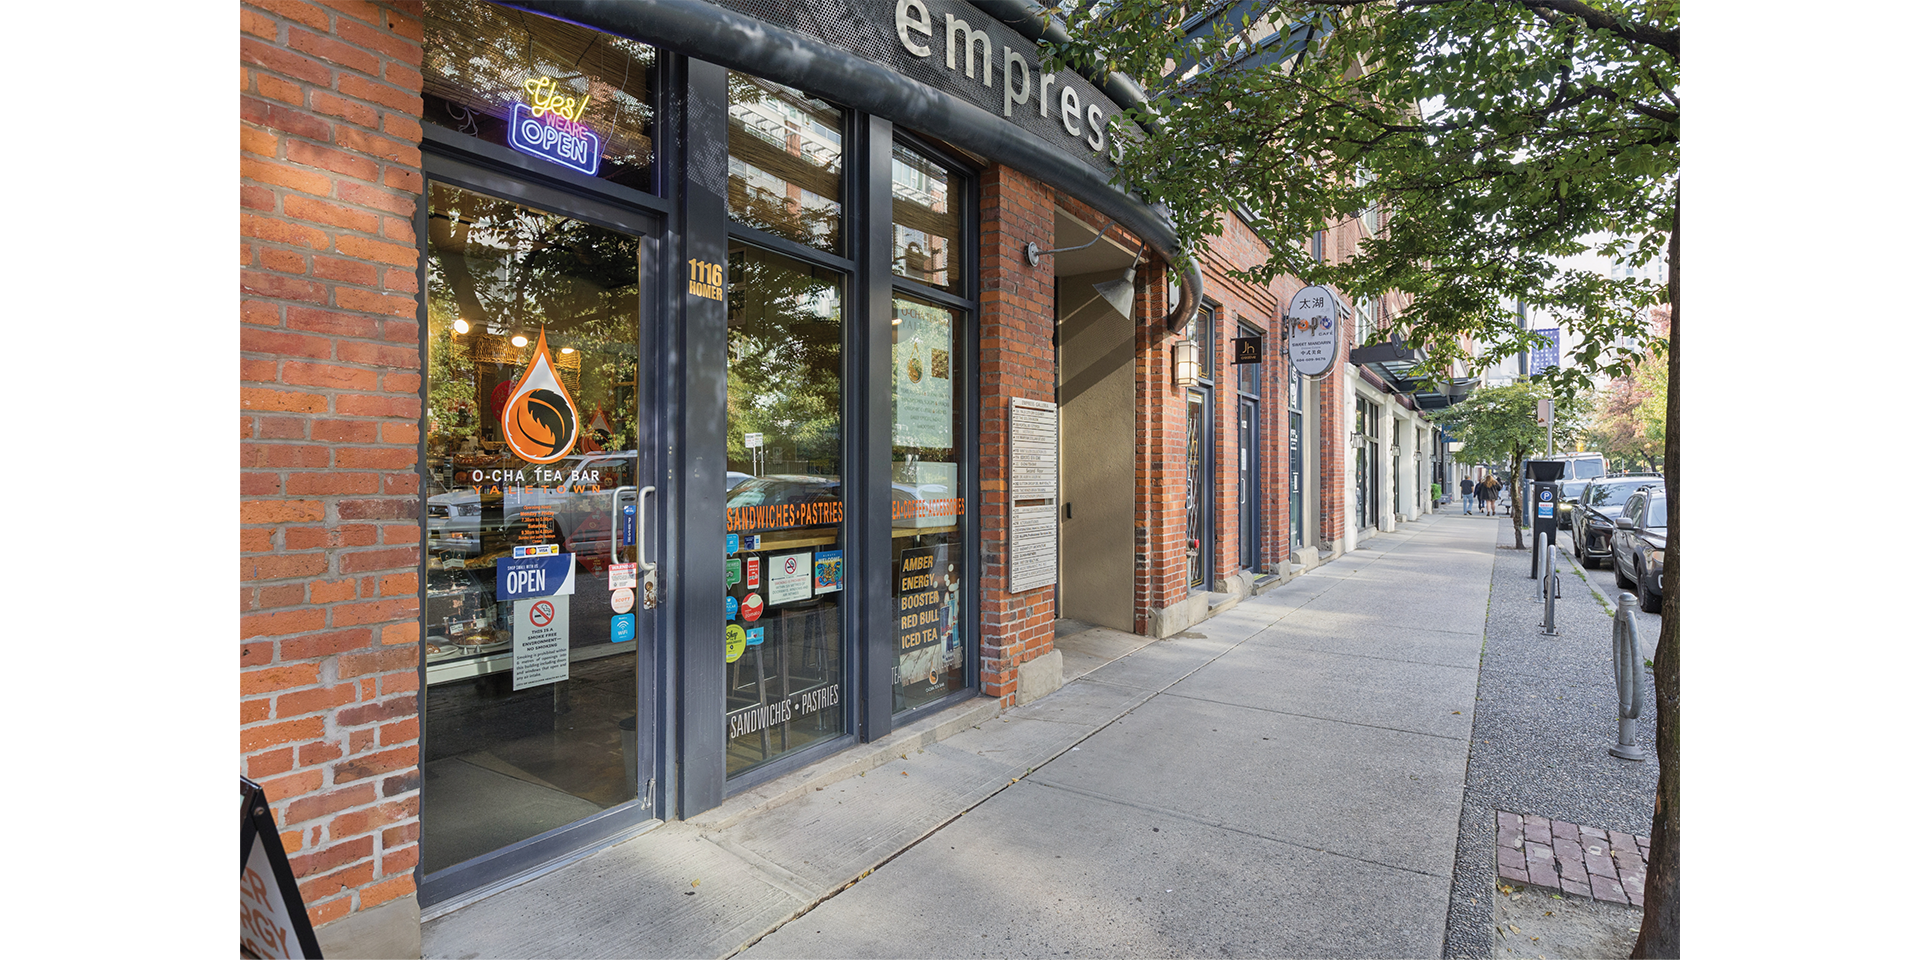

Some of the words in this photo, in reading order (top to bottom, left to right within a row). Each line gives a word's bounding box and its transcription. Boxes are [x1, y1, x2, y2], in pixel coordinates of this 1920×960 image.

[895, 0, 1125, 166] empress
[525, 76, 590, 123] Yes!
[521, 119, 588, 164] OPEN
[688, 258, 723, 287] 1116
[688, 280, 723, 302] HOMER
[1299, 297, 1324, 310] 太湖
[472, 469, 525, 482] O-CHA
[534, 469, 563, 482] TEA
[571, 469, 600, 482] BAR
[472, 484, 601, 495] YALETOWN
[1543, 492, 1550, 500] P
[892, 500, 900, 520] EA
[902, 555, 934, 572] AMBER
[506, 569, 546, 595] OPEN
[902, 573, 935, 591] ENERGY
[901, 590, 940, 611] BOOSTER
[901, 613, 918, 630] RED
[920, 609, 940, 625] BULL
[901, 632, 921, 650] ICED
[922, 627, 938, 644] TEA
[730, 699, 791, 739] SANDWICHES
[802, 684, 839, 715] PASTRIES
